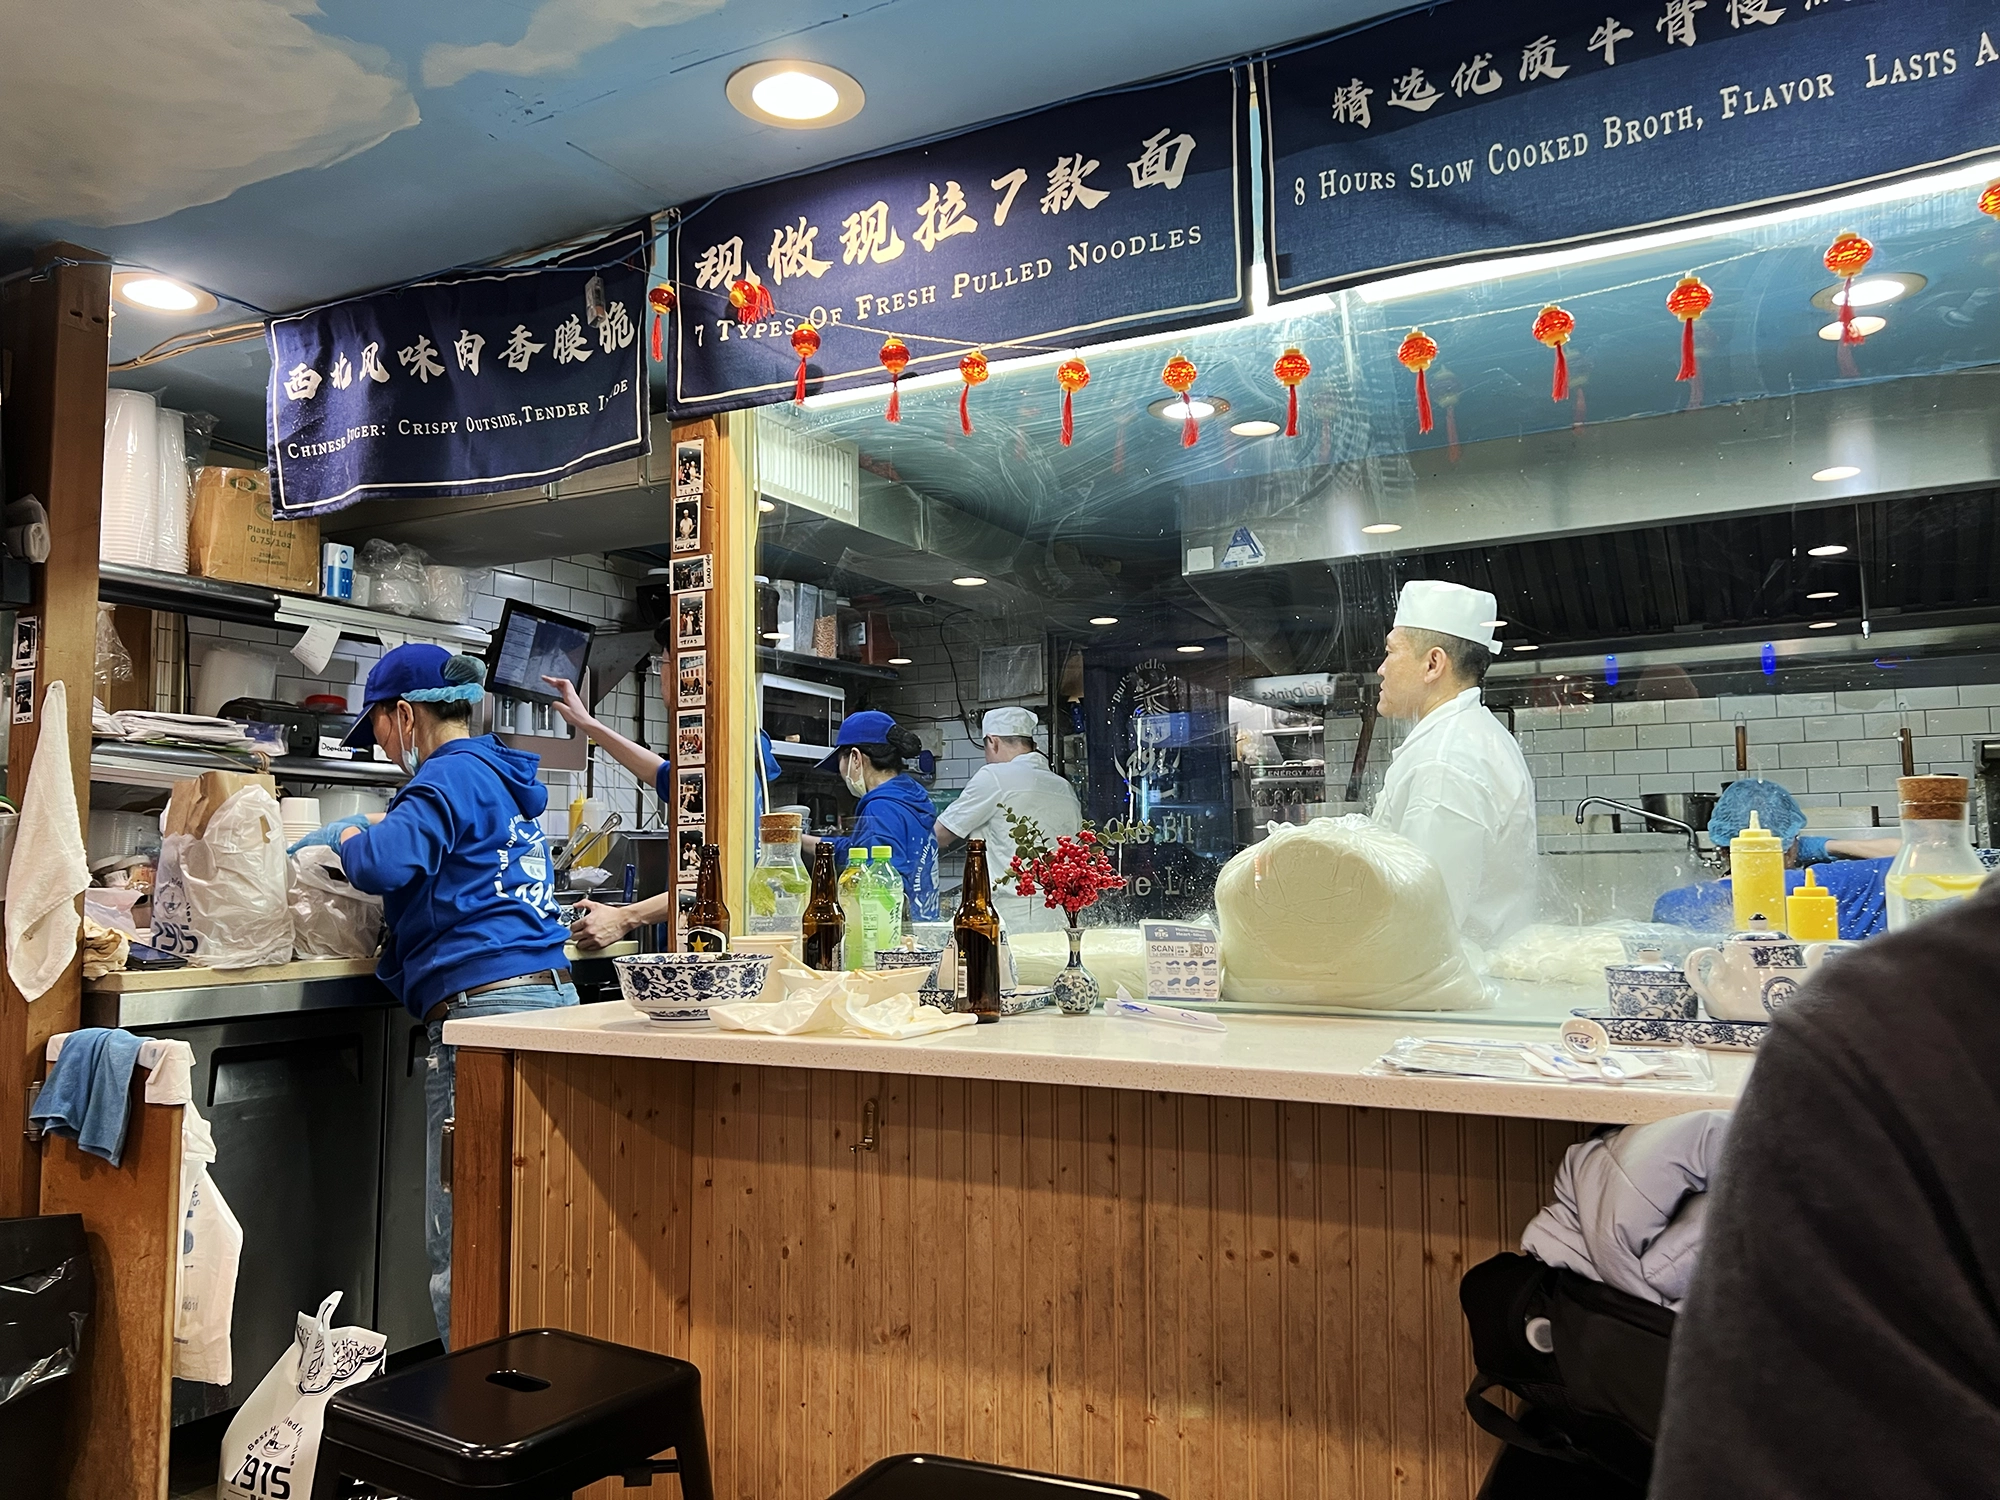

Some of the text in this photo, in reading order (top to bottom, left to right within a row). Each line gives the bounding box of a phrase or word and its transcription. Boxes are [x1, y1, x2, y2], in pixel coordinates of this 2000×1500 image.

[1332, 0, 1852, 128] 精选优质牛骨慢
[1294, 177, 1306, 206] 8
[1319, 167, 1396, 201] HOURS
[1410, 160, 1474, 190] SLOW
[1487, 142, 1589, 176] COOKED
[1603, 105, 1704, 149] BROTH,
[1721, 71, 1835, 120] FLAVOR
[1865, 46, 1956, 88] LASTS
[694, 224, 1202, 347] 7 TYPES OF FRESH PULLED NOODLES
[287, 436, 347, 459] CHINESE
[398, 419, 458, 435] CRISPY
[247, 524, 296, 539] Plastic Lids
[1151, 944, 1174, 953] SCAN
[1203, 945, 1215, 954] 02
[231, 1453, 291, 1500] 1915
